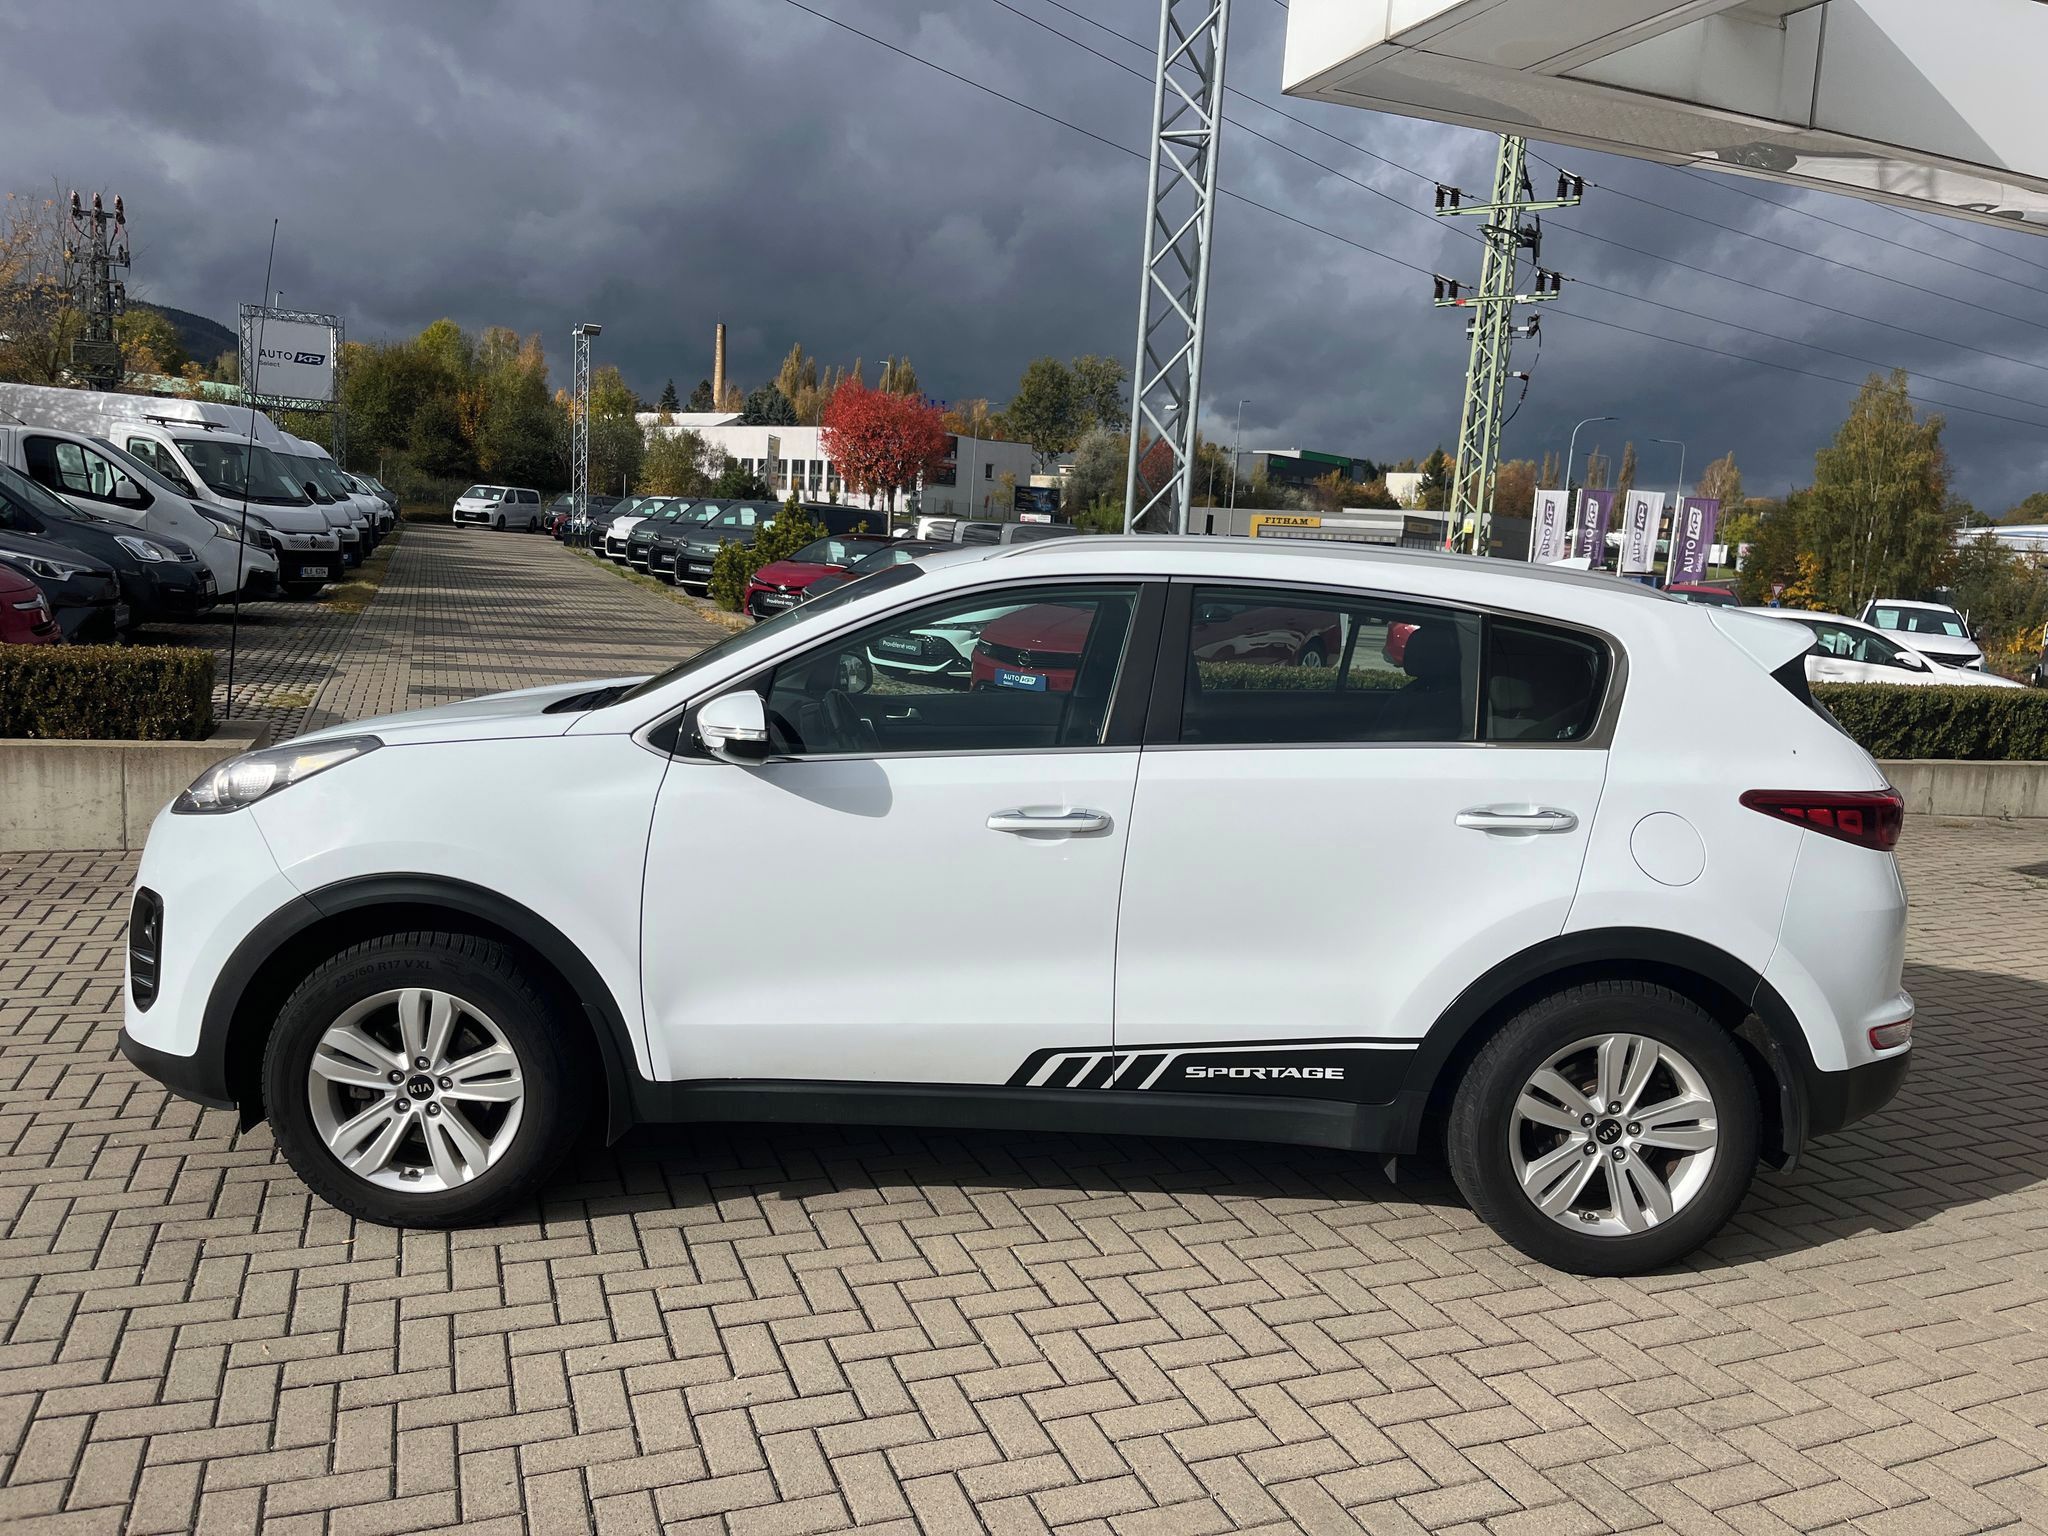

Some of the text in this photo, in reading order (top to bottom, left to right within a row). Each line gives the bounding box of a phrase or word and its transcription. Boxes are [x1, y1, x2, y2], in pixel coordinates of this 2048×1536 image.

[259, 349, 292, 360] AUTO
[1265, 516, 1308, 525] FITHAM
[1542, 528, 1551, 557] AUTO
[1583, 528, 1594, 558] AUTO
[1633, 532, 1642, 564] AUTO
[1684, 540, 1696, 573] AUTO
[1003, 673, 1020, 682] AUTO
[1185, 1066, 1345, 1080] SPORTAGE
[409, 1083, 432, 1094] KIA
[1599, 1123, 1620, 1141] KIA
